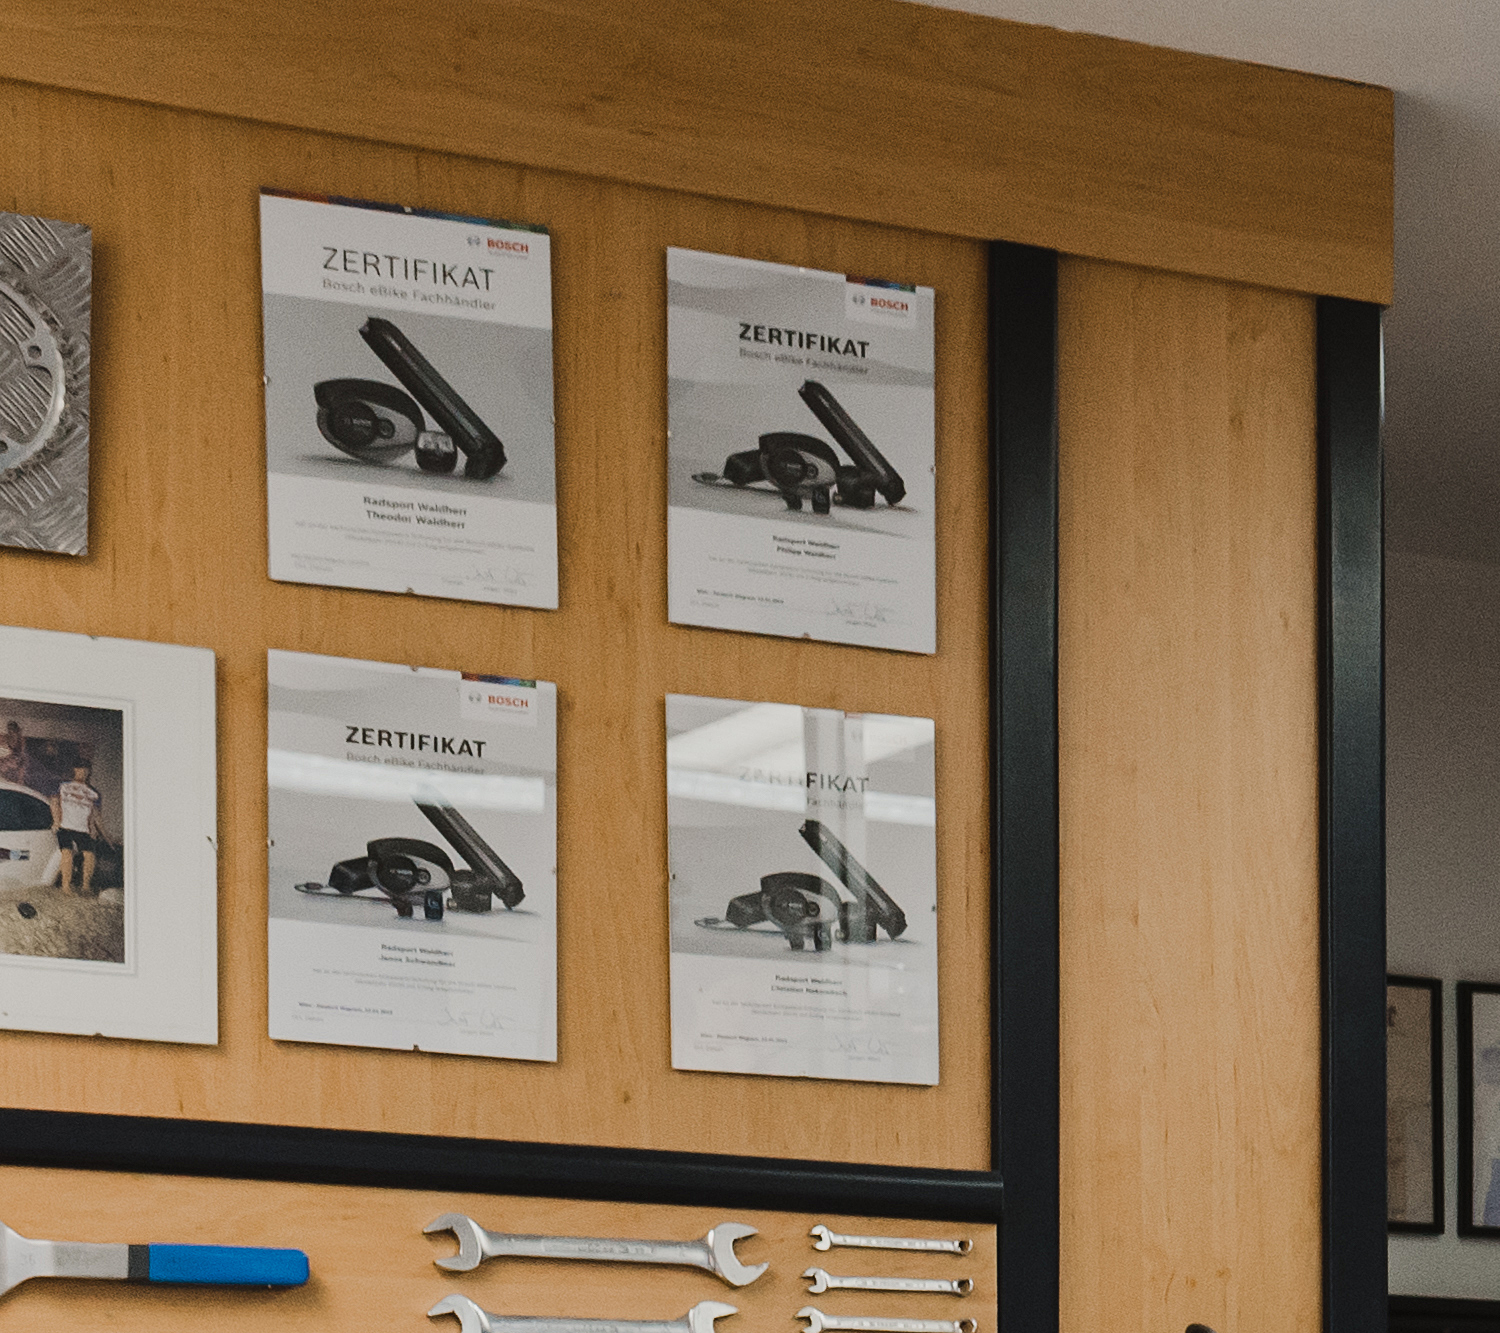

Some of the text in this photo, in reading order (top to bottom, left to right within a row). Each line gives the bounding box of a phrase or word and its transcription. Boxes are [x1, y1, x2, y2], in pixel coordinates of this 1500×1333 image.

[487, 237, 529, 254] BOSCH
[322, 246, 494, 291] ZERTIFIKAT
[322, 278, 365, 294] Bosch
[870, 296, 908, 311] BOSCH
[738, 322, 870, 359] ZERTIFIKAT
[363, 495, 415, 511] Radsport
[488, 694, 529, 709] BOSCH
[345, 725, 486, 758] ZERTIFIKAT
